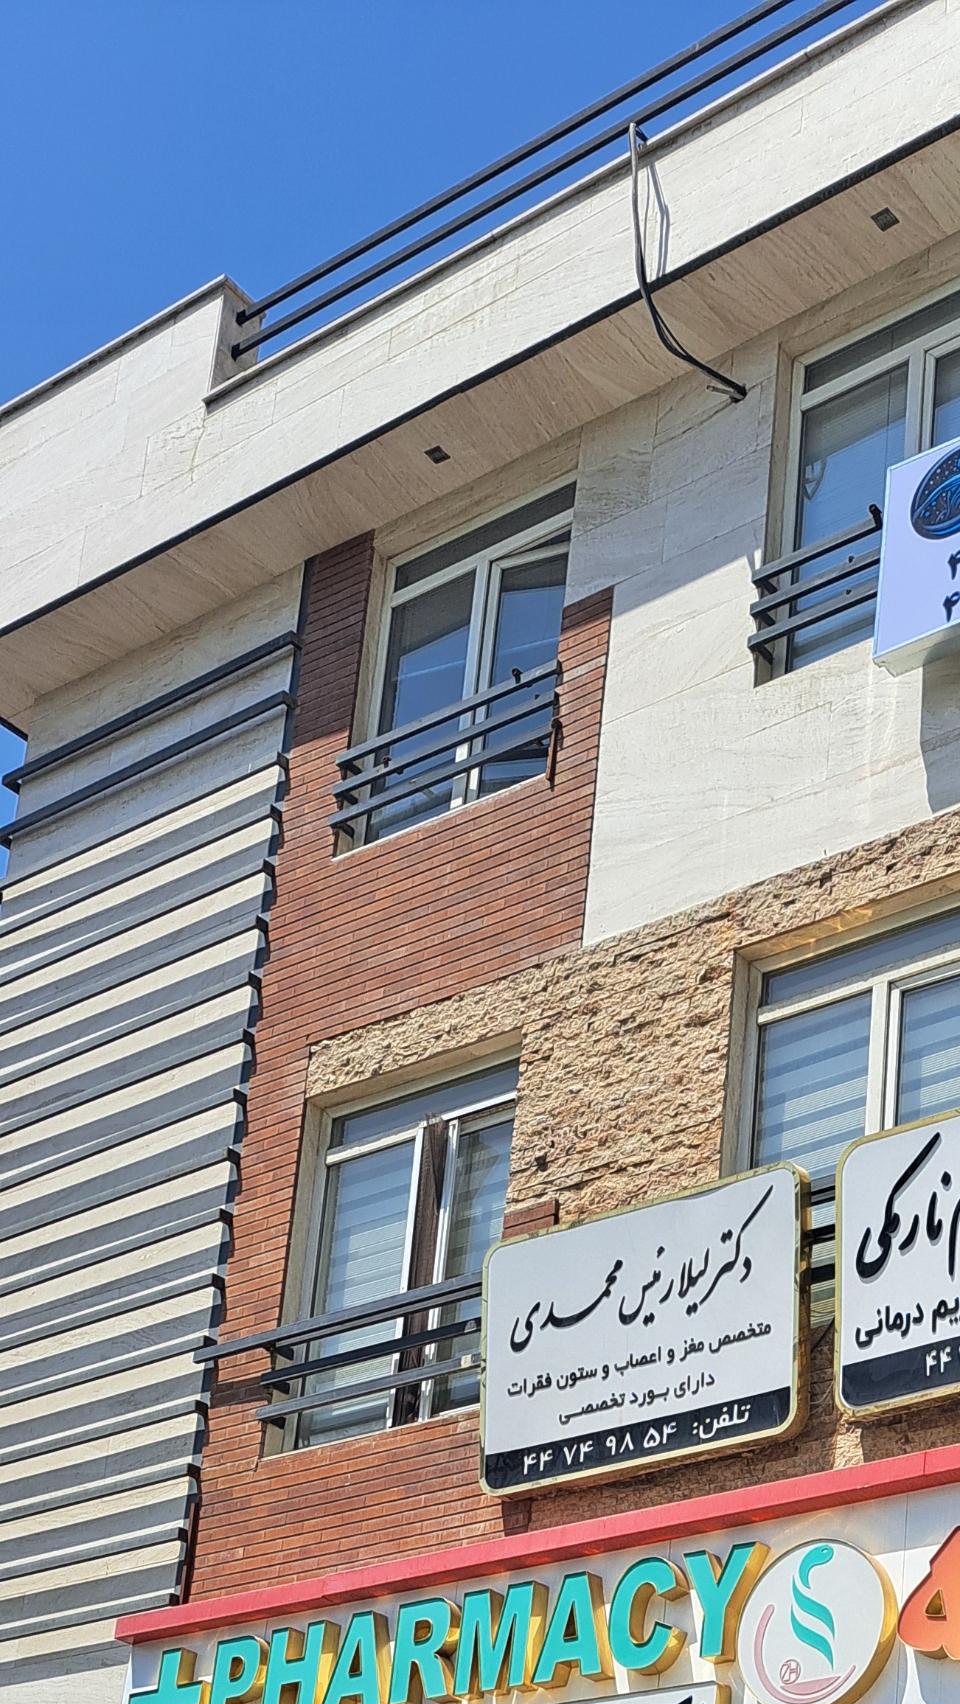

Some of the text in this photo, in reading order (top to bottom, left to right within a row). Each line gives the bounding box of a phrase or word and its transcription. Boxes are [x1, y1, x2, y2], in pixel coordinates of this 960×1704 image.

[699, 1185, 773, 1305] دکتر
[510, 1259, 623, 1351] محمدی
[678, 1248, 709, 1315] لیلا
[855, 1302, 922, 1347] درمانی
[507, 1323, 772, 1398] متخصص مغز و اعصاب و ستون فقرات
[674, 1373, 714, 1401] دارای
